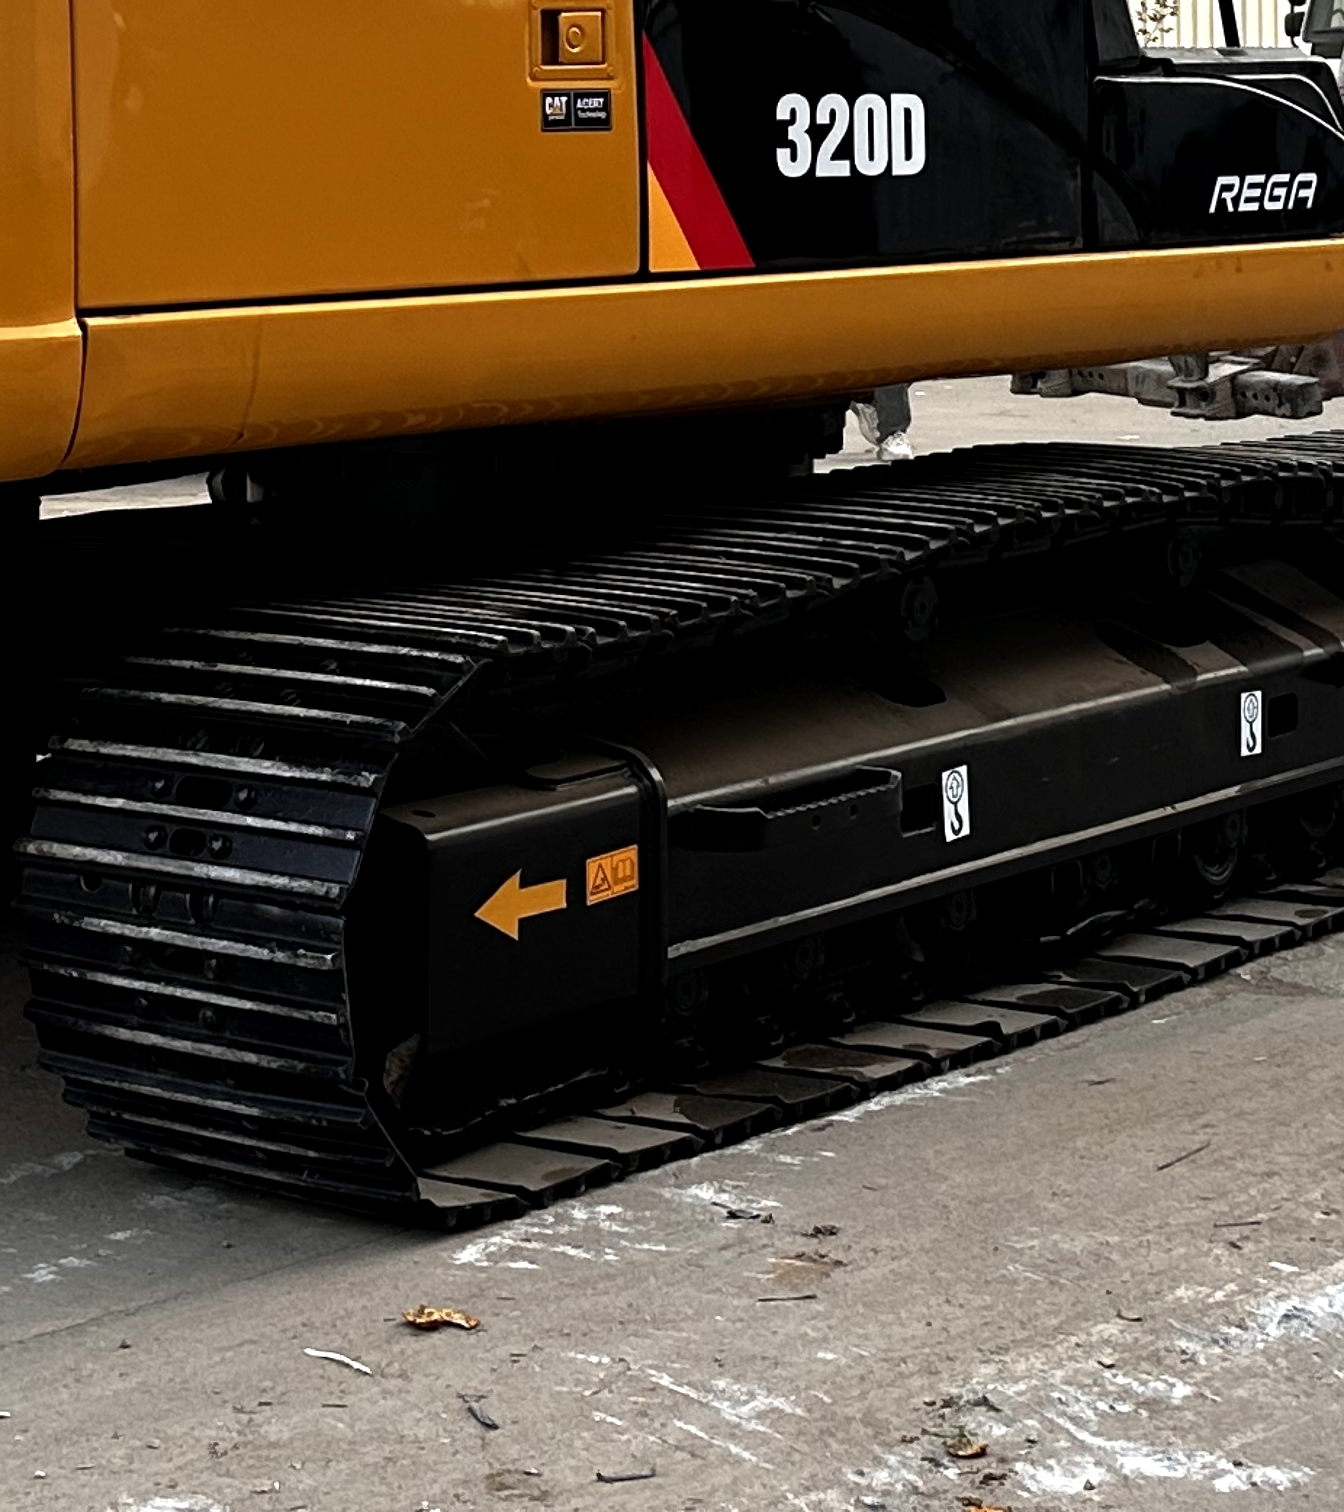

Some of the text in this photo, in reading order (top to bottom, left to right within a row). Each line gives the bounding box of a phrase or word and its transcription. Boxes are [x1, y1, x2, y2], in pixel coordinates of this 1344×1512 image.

[545, 96, 568, 115] CAT
[775, 92, 927, 178] 320D
[1208, 172, 1318, 214] REGA
